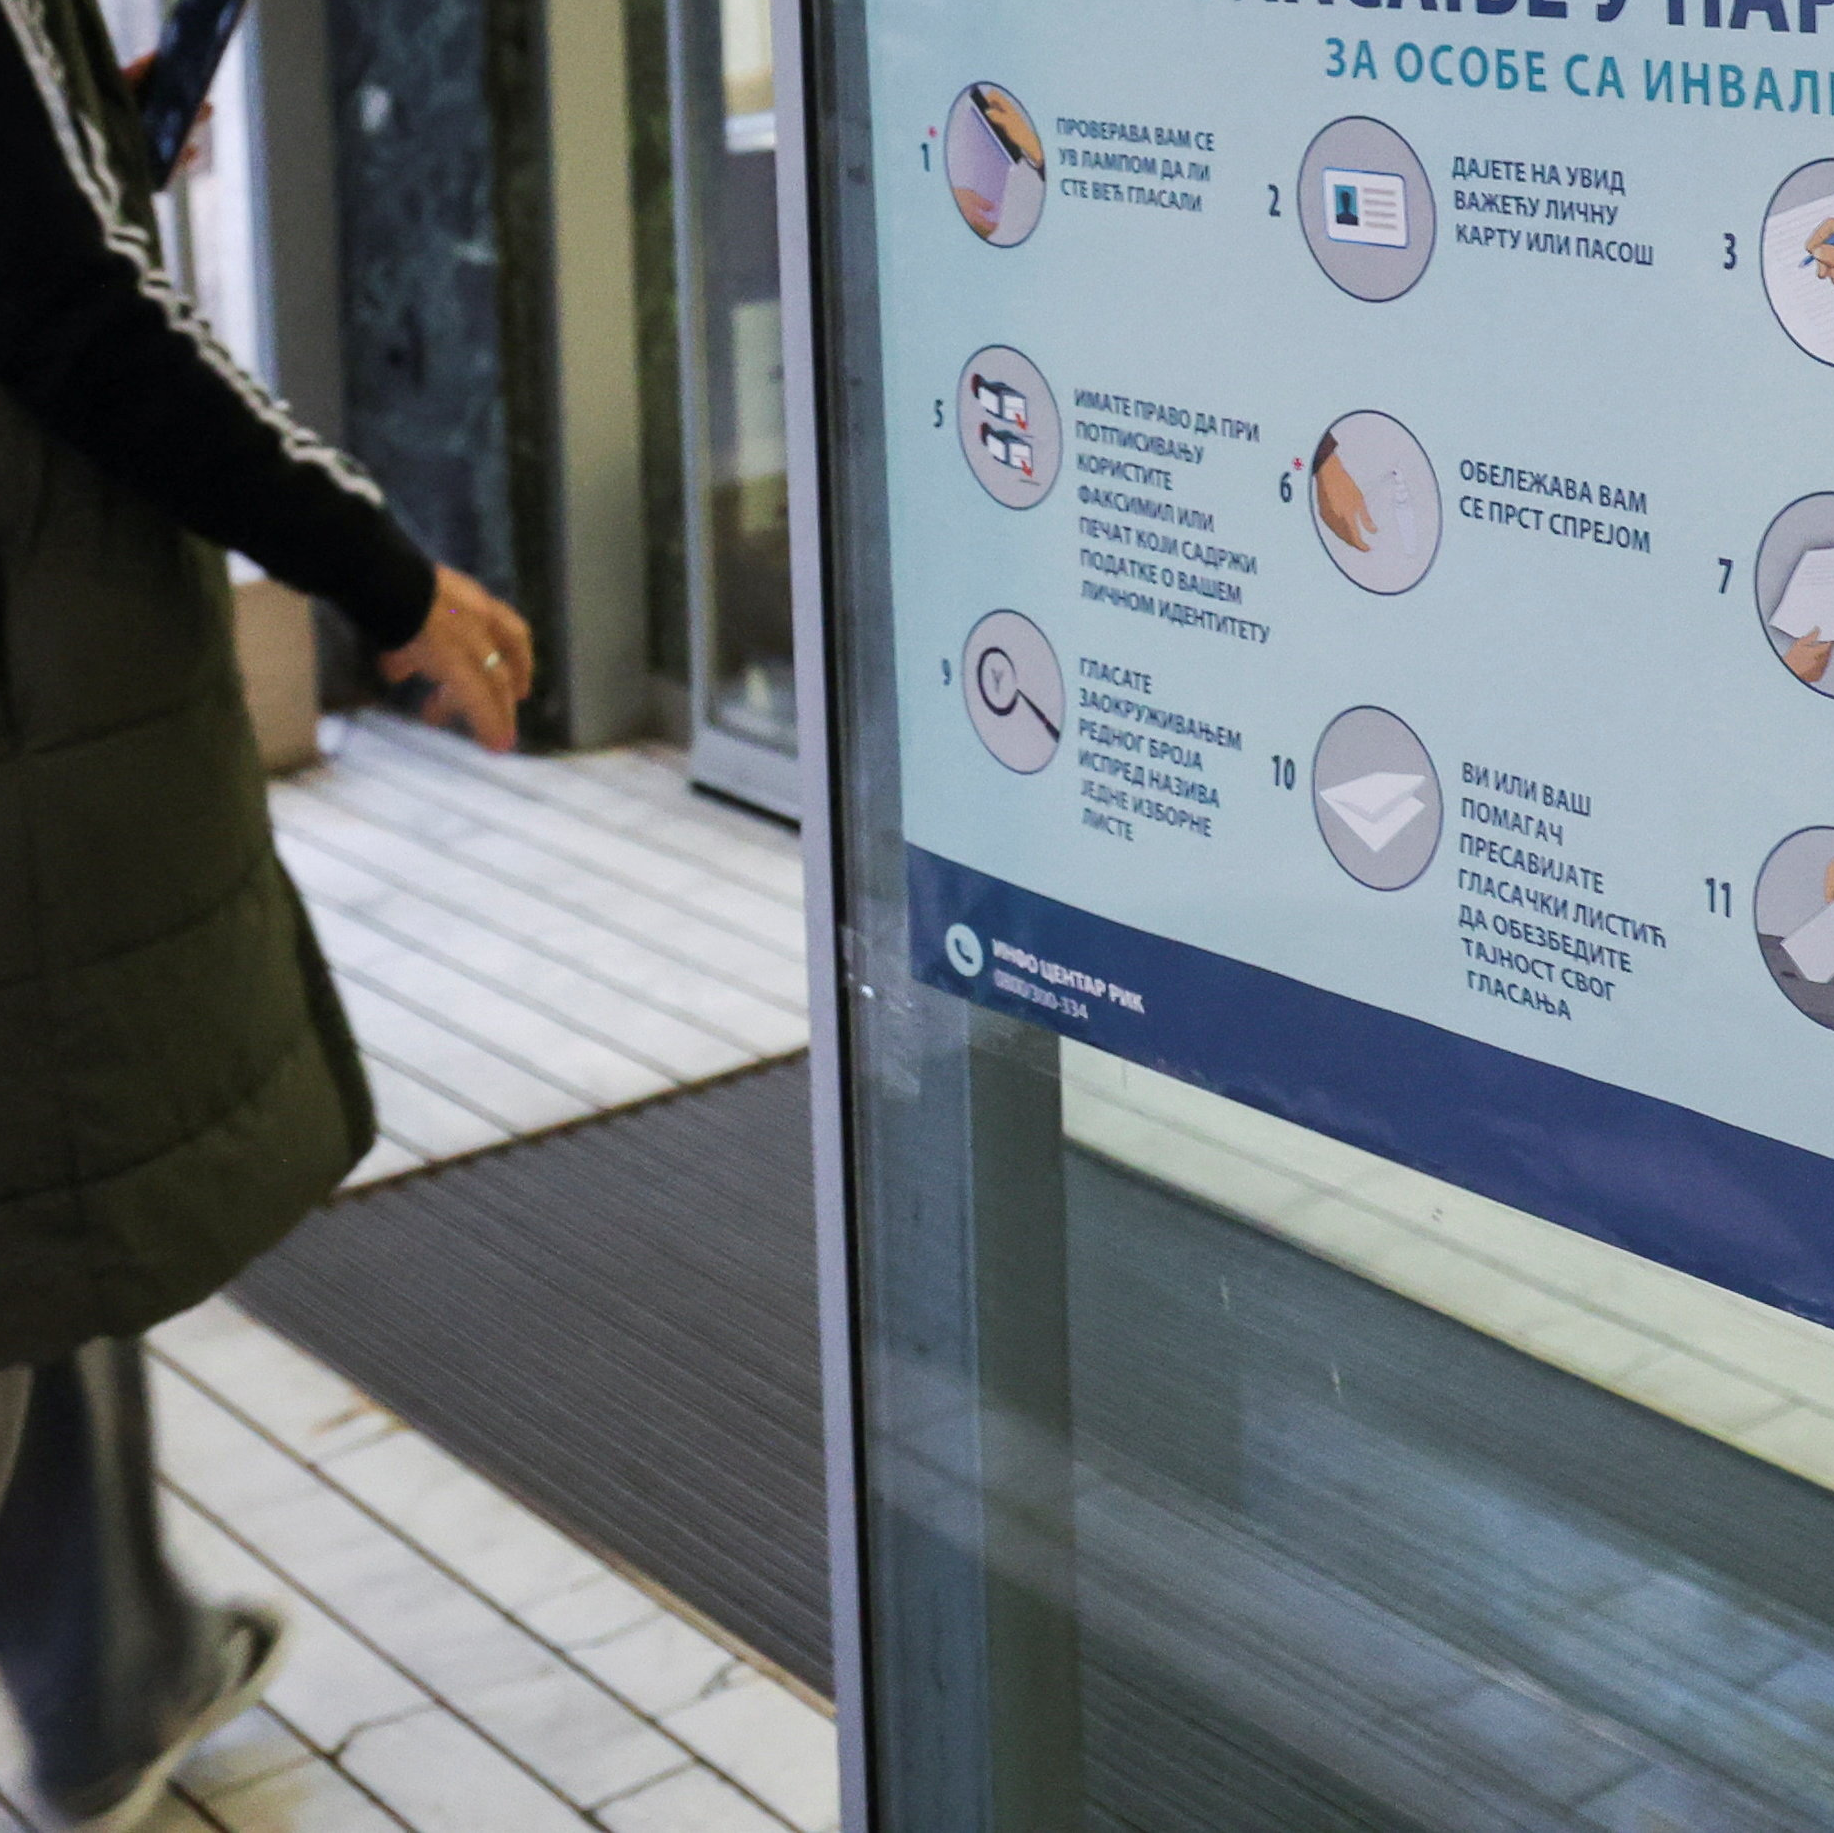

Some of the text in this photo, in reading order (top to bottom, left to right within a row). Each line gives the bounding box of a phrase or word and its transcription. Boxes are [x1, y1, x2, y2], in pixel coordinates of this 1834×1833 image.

[1324, 38, 1375, 79] ЗА
[1396, 45, 1547, 92] ОСОБЕ
[1565, 53, 1624, 98] СА
[1057, 118, 1215, 151] ПРОВЕРАВА ВАМ СЕ
[921, 143, 930, 171] 1
[1452, 156, 1626, 196] ДАЈЕТЕ НА УВИД
[1060, 178, 1202, 212] СТЕ ВЕЋ ГЛАСАЛИ
[1269, 185, 1280, 216] 2
[1455, 191, 1618, 226] ВАЖЕЋУ ЛИЧНУ
[1456, 224, 1654, 266] КАРТУ ИЛИ ПАСОШ
[1724, 233, 1737, 269] 3
[934, 400, 944, 428] 5
[1074, 389, 1260, 443] ИМАТЕ ПРАВО ДА ПРИ
[1075, 421, 1203, 465] ПОТПИСИВАЊУ
[1280, 472, 1292, 502] 6
[1460, 459, 1647, 515] ОБЕЛЕЖАВА ВАМ
[1460, 496, 1650, 553] СЕ ПРСТ СПРЕЈОМ
[1718, 558, 1733, 593] 7
[1080, 658, 1151, 694] ГЛАСАТЕ
[1271, 755, 1295, 790] 10
[1463, 762, 1591, 817] ВИ ИЛИ ВАШ
[1462, 798, 1563, 847] ПОМАГАЧ
[1461, 833, 1604, 895] ПРЕСАВИЈАТЕ
[1459, 869, 1667, 949] ГЛАСАЧКИ ЛИСТИЋ
[1706, 878, 1731, 918] 11
[1458, 905, 1632, 973] ДА ОБЕЗБЕДИТЕ
[1462, 938, 1615, 1002] ТАЈНОСТ СВОГ
[1467, 971, 1572, 1020] ГЛАСАЊА
